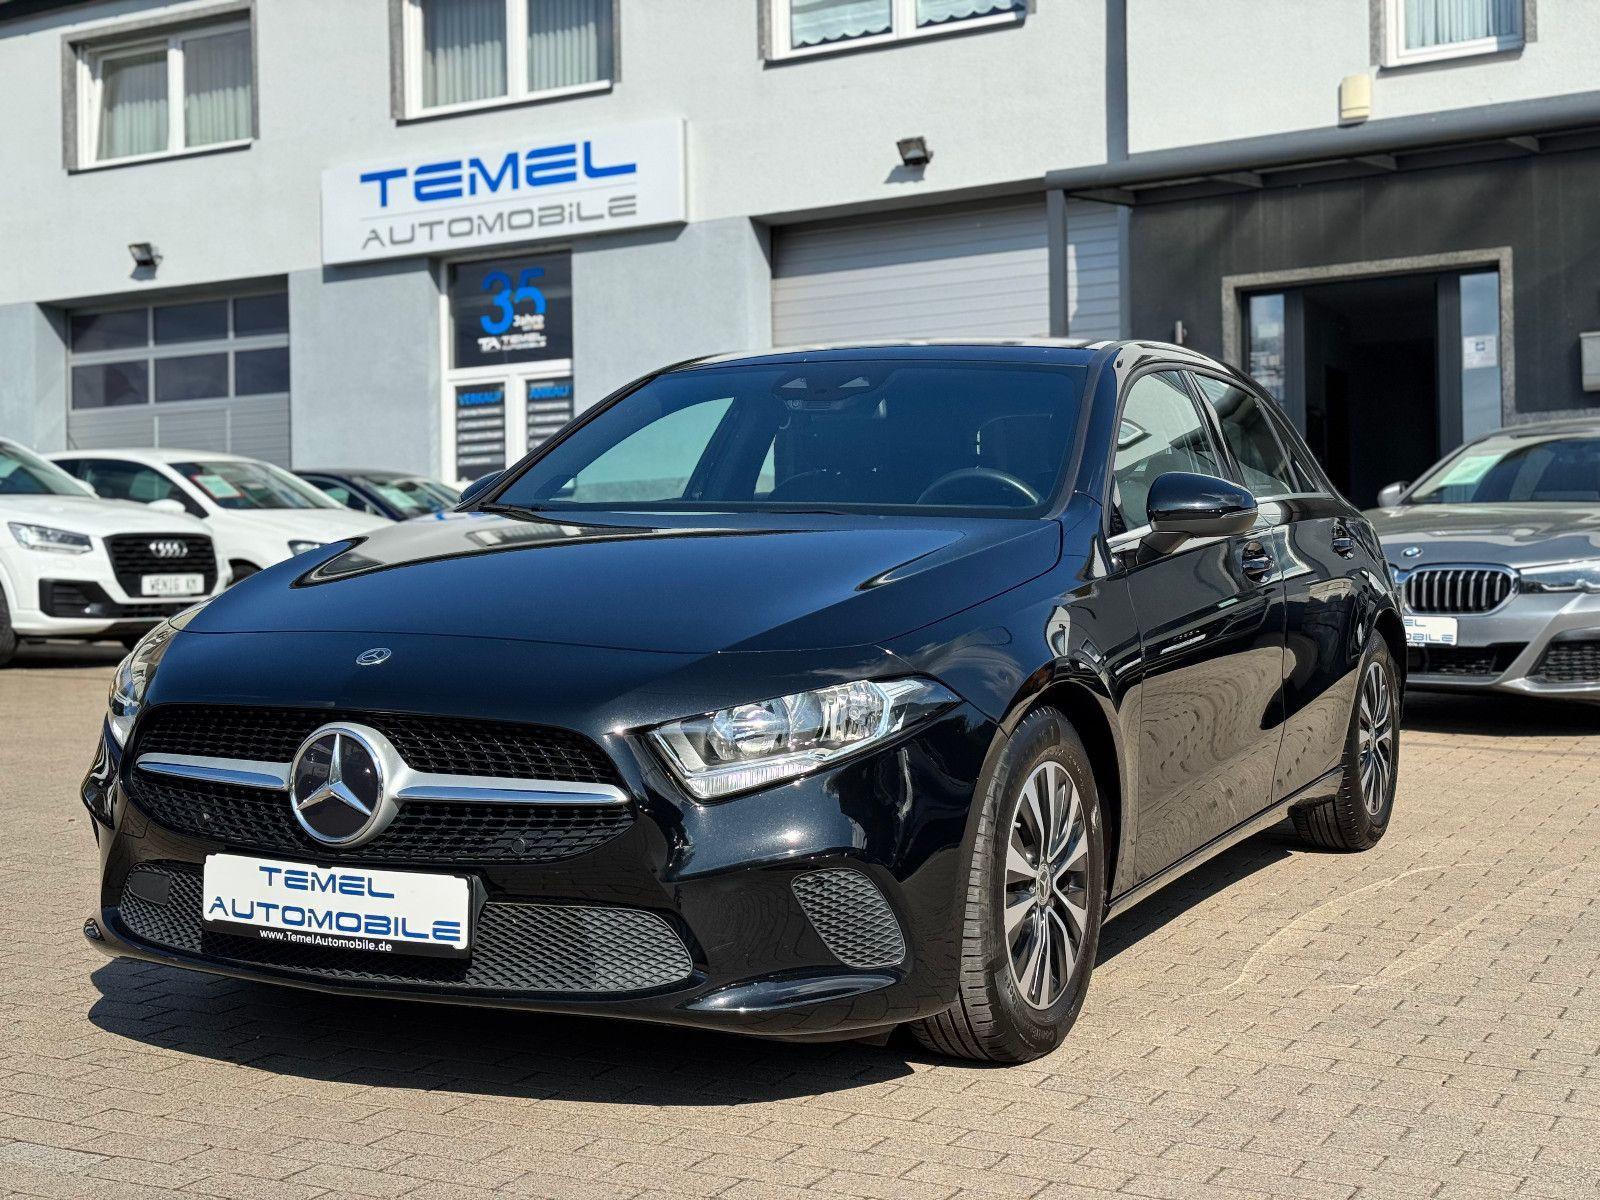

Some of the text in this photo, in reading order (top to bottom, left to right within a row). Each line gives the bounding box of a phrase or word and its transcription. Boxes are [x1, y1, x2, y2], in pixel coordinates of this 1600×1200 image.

[359, 141, 637, 208] TEMEL
[480, 267, 546, 334] 35
[1404, 618, 1427, 628] EL
[1406, 632, 1454, 642] OBILE
[258, 865, 395, 899] TEMEL
[208, 896, 461, 942] AUTOMOBILE
[259, 929, 393, 952] www.TemelAutomobile.de
